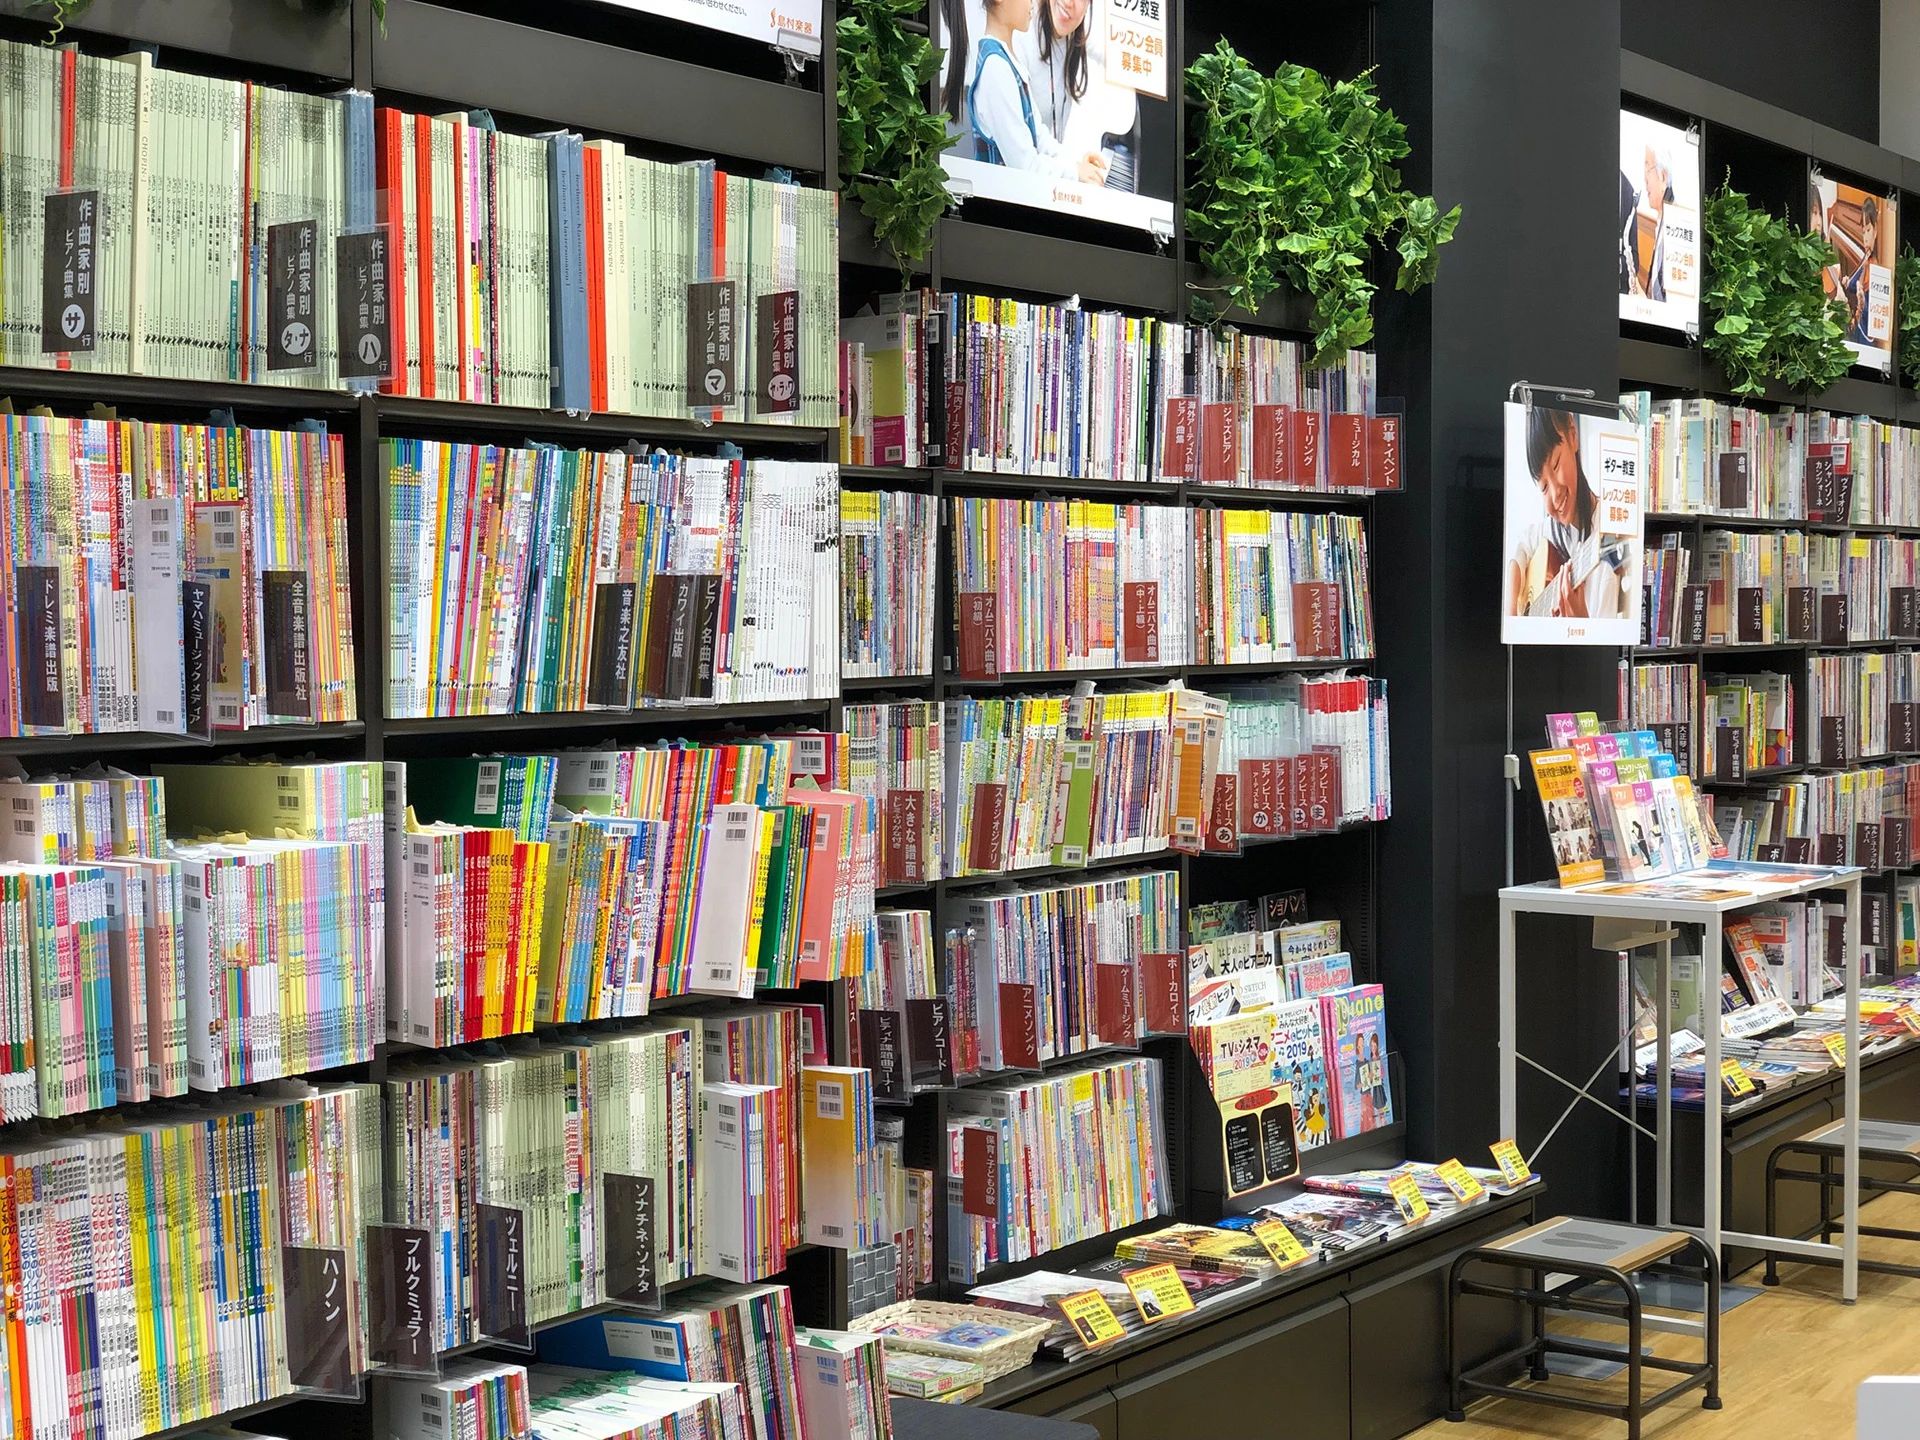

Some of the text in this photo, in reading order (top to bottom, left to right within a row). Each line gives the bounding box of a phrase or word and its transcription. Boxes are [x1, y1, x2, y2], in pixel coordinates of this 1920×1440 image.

[1110, 24, 1164, 57] レッスン会員
[1120, 51, 1153, 77] 募集中
[63, 229, 74, 299] ピアノ曲集
[77, 198, 92, 295] 作曲家別
[299, 226, 312, 316] 作曲家別
[286, 255, 296, 320] ピアノ曲集
[359, 266, 369, 329] ピアノ曲集
[371, 238, 385, 325] 作曲家別
[65, 311, 91, 346] サ 行
[282, 329, 313, 363] タ・ナ 行
[361, 341, 388, 371] ハ 行
[706, 310, 716, 365] ピアノ曲集
[718, 286, 731, 362] 作曲家別
[772, 320, 781, 373] ピアノ曲集
[783, 296, 795, 369] 作曲家別
[707, 375, 732, 402] マ 行
[788, 399, 797, 408] 行
[948, 385, 963, 465] 国内アーティスト別
[1222, 407, 1233, 464] ジャズピアノ
[1303, 415, 1316, 466] ヒーリング
[1351, 417, 1361, 468] ミュージカル
[1382, 420, 1395, 486] 行事・イベント
[1602, 488, 1637, 505] レッスン会員
[1604, 457, 1636, 477] ギター教室
[1738, 456, 1746, 473] 合唱
[1815, 461, 1823, 507] カンツォーネ
[1824, 461, 1833, 507] シャンソン
[1609, 506, 1630, 523] 募集中
[44, 579, 59, 692] ドレミ楽譜出版
[292, 580, 307, 701] 全音楽譜出版社
[615, 588, 633, 680] 音楽之友社
[671, 583, 689, 658] カワイ出版
[697, 580, 716, 680] ピアノ名曲集
[984, 596, 996, 676] オムニバス曲集
[1146, 586, 1158, 658] オムニバス曲集
[1309, 587, 1322, 652] フィギュアスケート
[1753, 590, 1761, 630] ハーモニカ
[190, 587, 206, 726] ヤマハミュージックメディア
[1224, 777, 1234, 827] ピアノピース
[1261, 762, 1272, 811] ピアノピース
[1276, 762, 1286, 811] ピアノピース
[1297, 759, 1308, 807] ピアノピース
[1319, 756, 1328, 804] ピアノピース
[904, 794, 917, 878] 大きな譜面
[989, 787, 1004, 864] スタジオジブリ
[1269, 896, 1300, 917] ショパン
[1167, 958, 1180, 1027] ボーカロイド
[1220, 951, 1272, 975] 大人のピアニカ
[1022, 988, 1035, 1057] アニメソング
[1120, 968, 1131, 1040] ゲームミュージック
[932, 1003, 948, 1072] ピアノコード
[1286, 1041, 1307, 1059] 2019
[985, 1134, 996, 1206] 保育・子どもの歌
[504, 1211, 519, 1312] ツェルニー
[635, 1183, 650, 1293] ソナチネ・ソナタ
[322, 1257, 341, 1322] ハノン
[404, 1237, 424, 1355] ブルクミュラー
